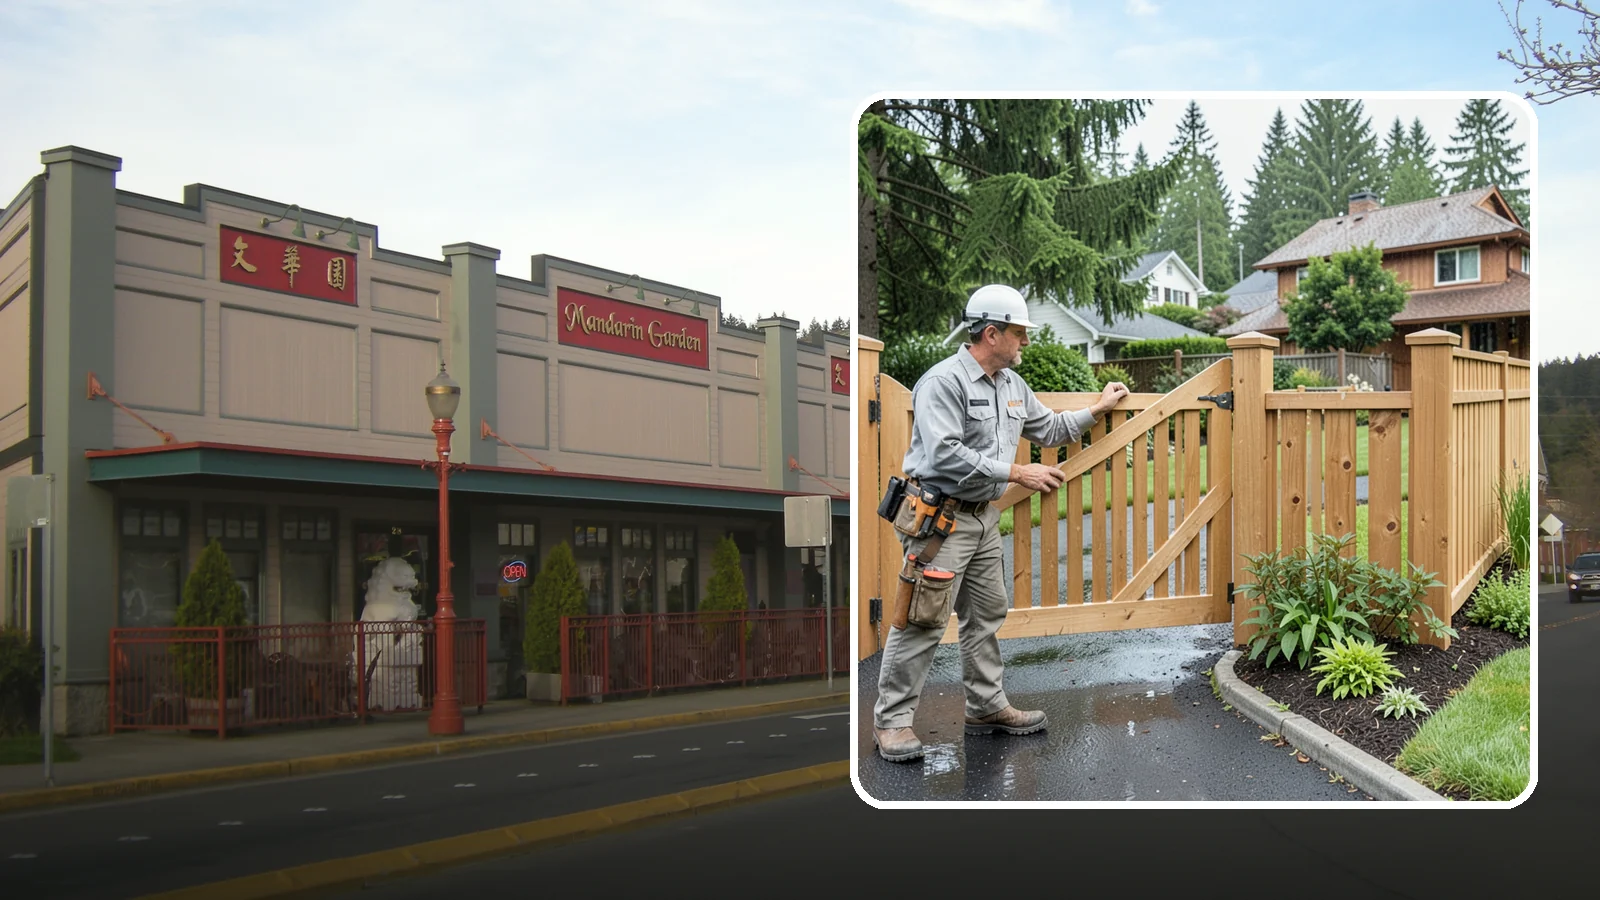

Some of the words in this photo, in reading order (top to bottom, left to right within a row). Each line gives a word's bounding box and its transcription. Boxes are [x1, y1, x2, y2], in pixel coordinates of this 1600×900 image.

[231, 235, 346, 291] 文華園
[564, 302, 644, 341] Mandarin
[647, 320, 701, 352] Garden
[503, 565, 527, 578] OPEN
